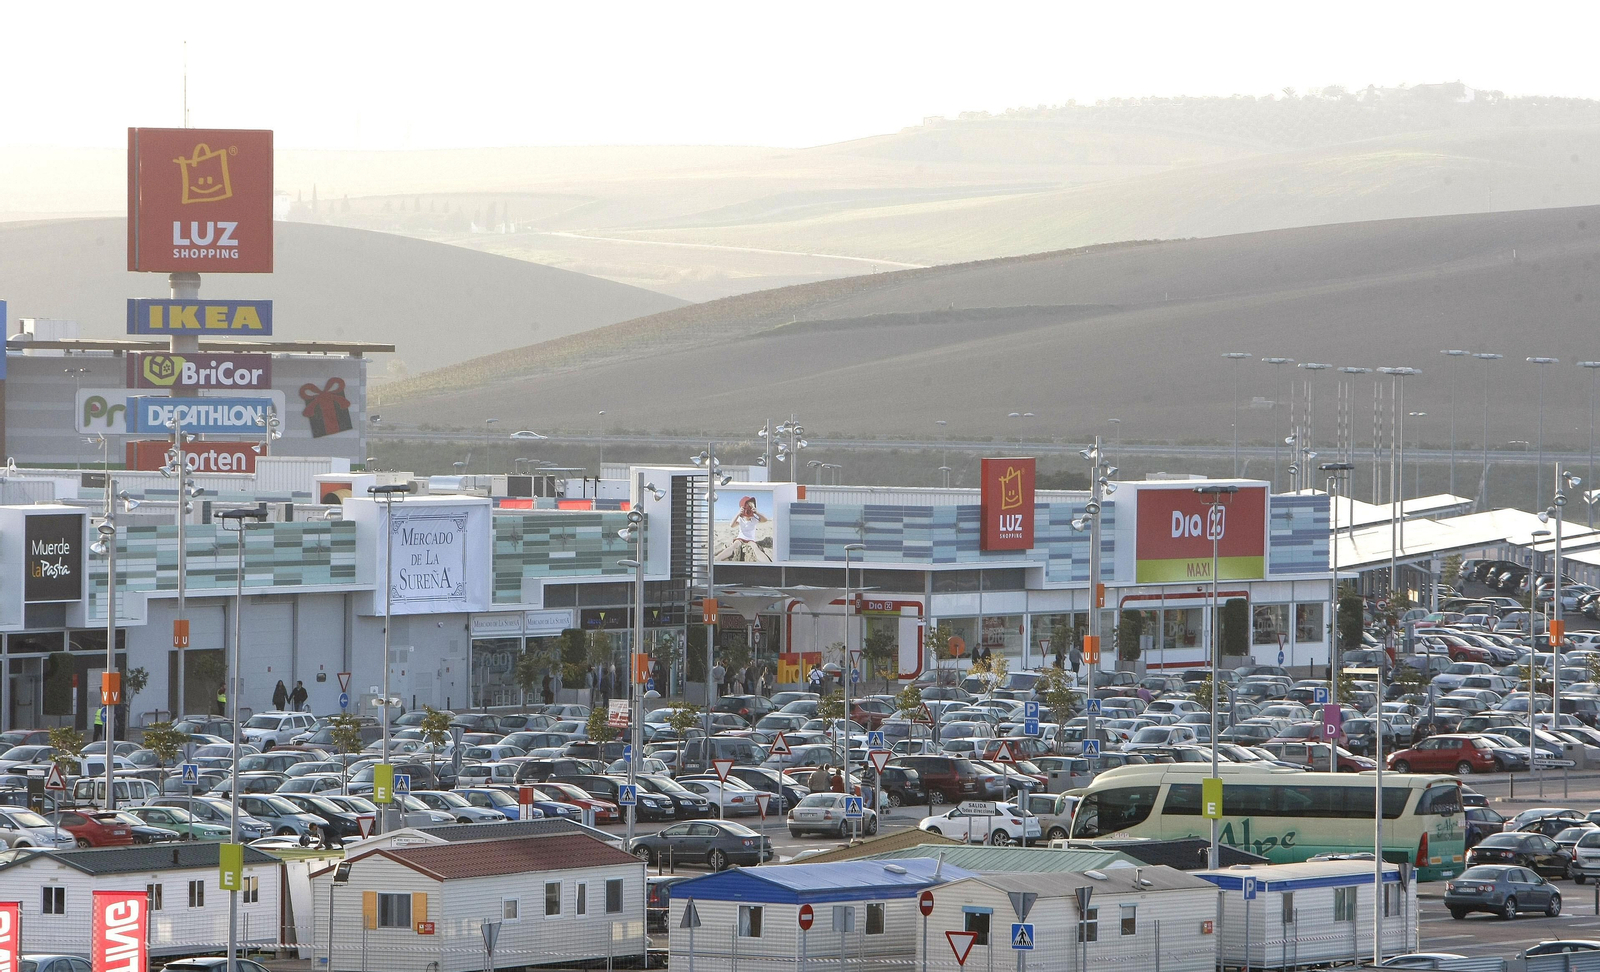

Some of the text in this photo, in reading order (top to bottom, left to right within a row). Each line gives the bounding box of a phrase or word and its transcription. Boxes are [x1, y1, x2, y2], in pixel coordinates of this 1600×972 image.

[173, 221, 239, 246] LUZ
[173, 248, 239, 259] SHOPPING
[149, 305, 263, 329] IKEA
[181, 360, 263, 386] BriCor
[147, 405, 262, 426] DECATHLON
[999, 514, 1023, 531] LUZ
[401, 527, 454, 546] MERCADO
[31, 537, 70, 556] Muerde
[410, 549, 440, 566] DE LA
[1186, 562, 1211, 578] MAXI
[399, 566, 453, 591] SUREÑA
[711, 613, 716, 622] U
[174, 636, 179, 645] U
[182, 636, 188, 645] U
[1550, 635, 1556, 643] U
[1085, 652, 1090, 661] U
[1093, 652, 1099, 661] U
[112, 692, 118, 702] V
[1316, 688, 1326, 702] P
[1026, 703, 1036, 717] P
[1326, 724, 1336, 735] D
[377, 787, 386, 799] E
[1207, 802, 1216, 815] E
[1217, 817, 1296, 857] Alpe
[224, 871, 234, 886] E
[1246, 879, 1255, 898] P
